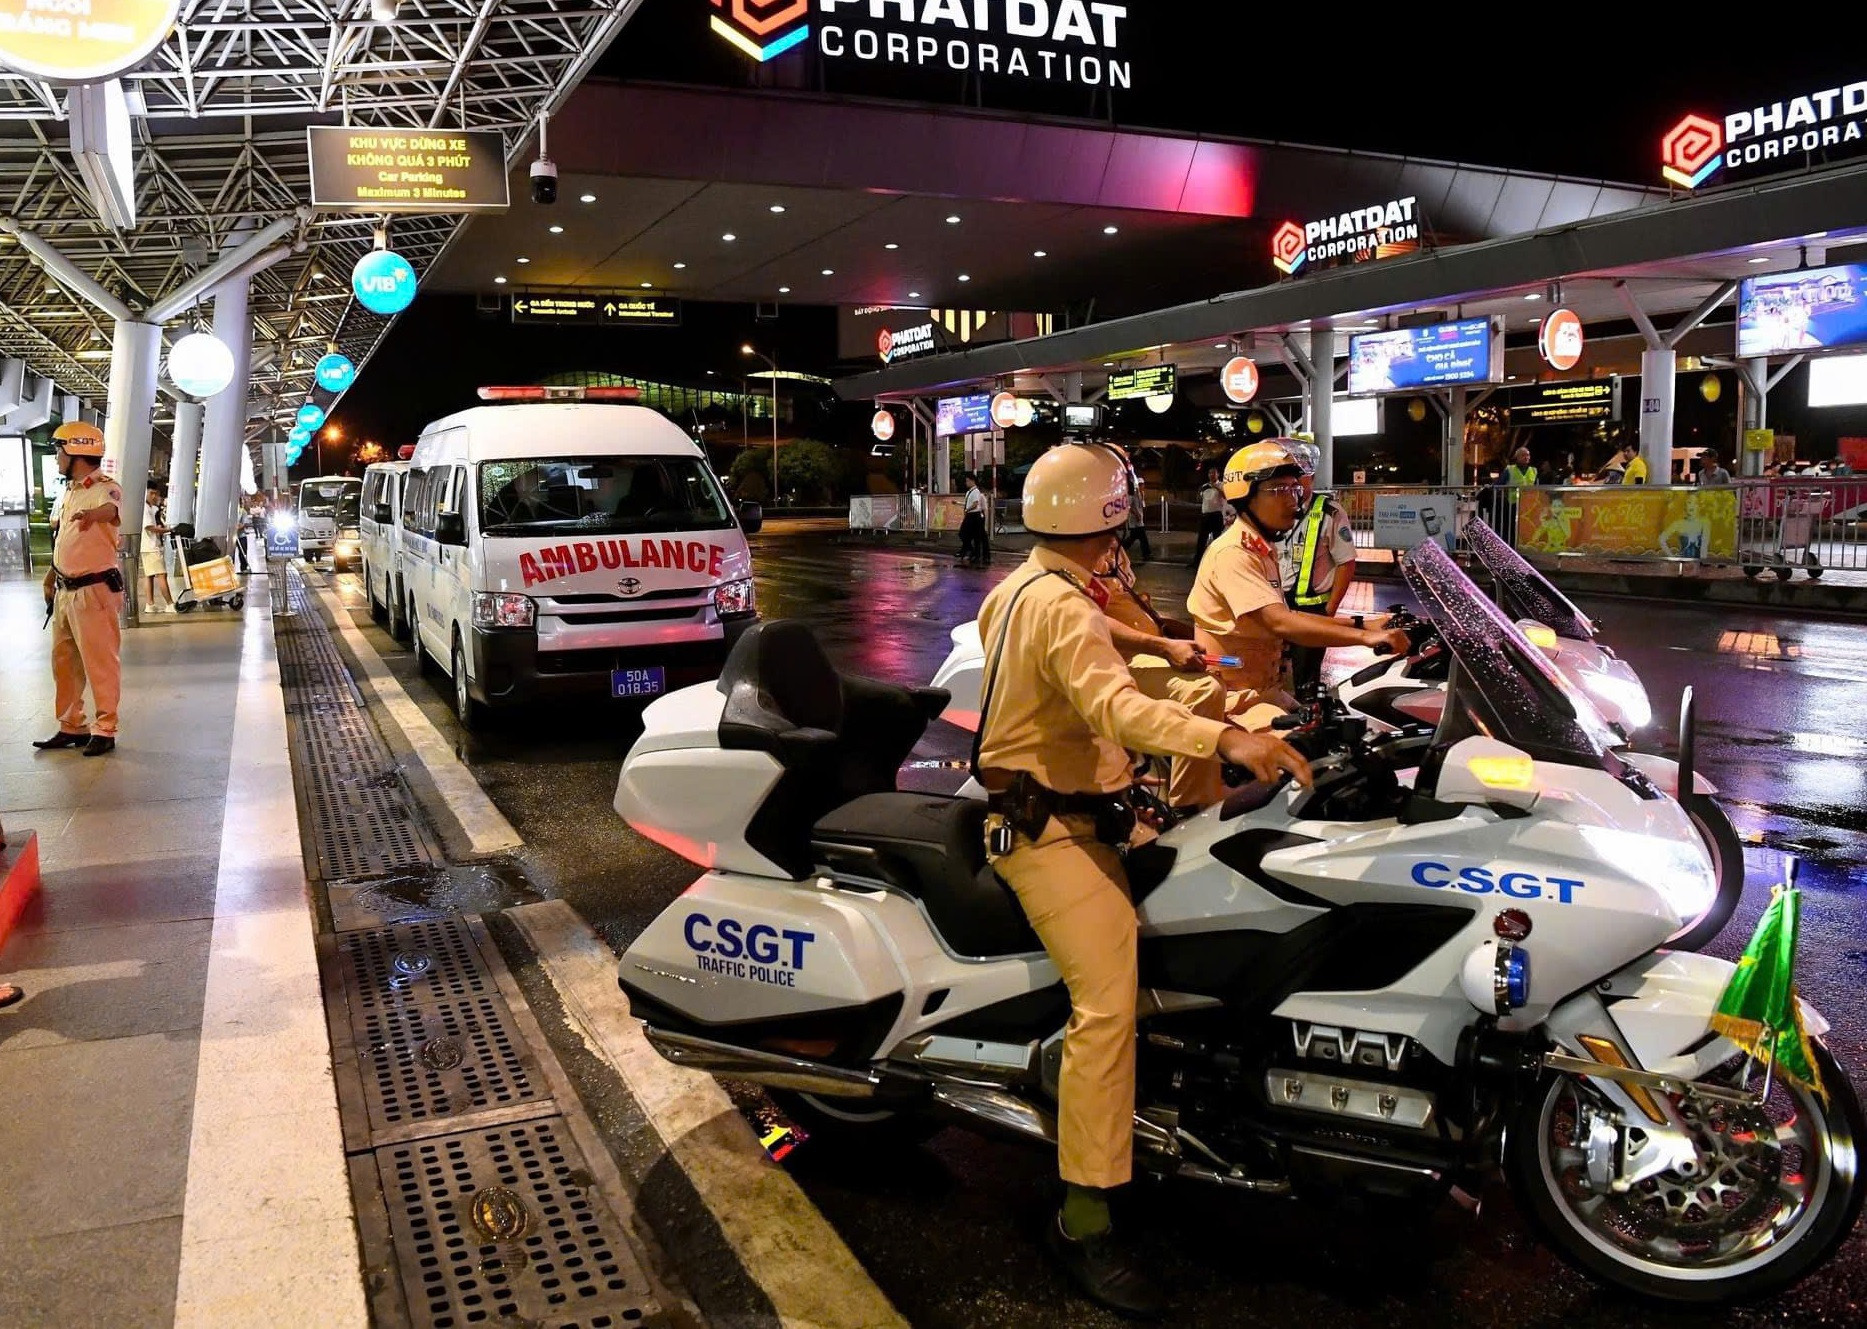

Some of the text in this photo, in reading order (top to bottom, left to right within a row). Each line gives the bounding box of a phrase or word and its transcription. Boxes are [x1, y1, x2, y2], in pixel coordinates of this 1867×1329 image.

[820, 0, 1127, 48] ATDAT
[821, 25, 1131, 89] CORPORATION
[350, 136, 466, 151] KHU VỰC DỪNG XE
[1726, 119, 1867, 168] CORPORA
[347, 152, 471, 168] KHÔNG QUÁ 3 PHÚT
[378, 171, 443, 185] Car Parking
[357, 187, 466, 199] Maximum 3 Minutes
[1305, 196, 1415, 245] PHATDAT
[1307, 223, 1418, 262] CORPORATION
[360, 276, 396, 292] VIB
[891, 323, 933, 346] PHATDAT
[893, 339, 935, 357] CORPORATION
[518, 538, 725, 588] AMBULANCE
[618, 681, 659, 695] 018.35
[626, 669, 649, 682] 50A
[1411, 861, 1585, 904] C.S.G.T
[684, 913, 815, 970] C.S.G.T
[696, 954, 746, 978] TRAFFIC
[750, 965, 796, 987] POLICE
